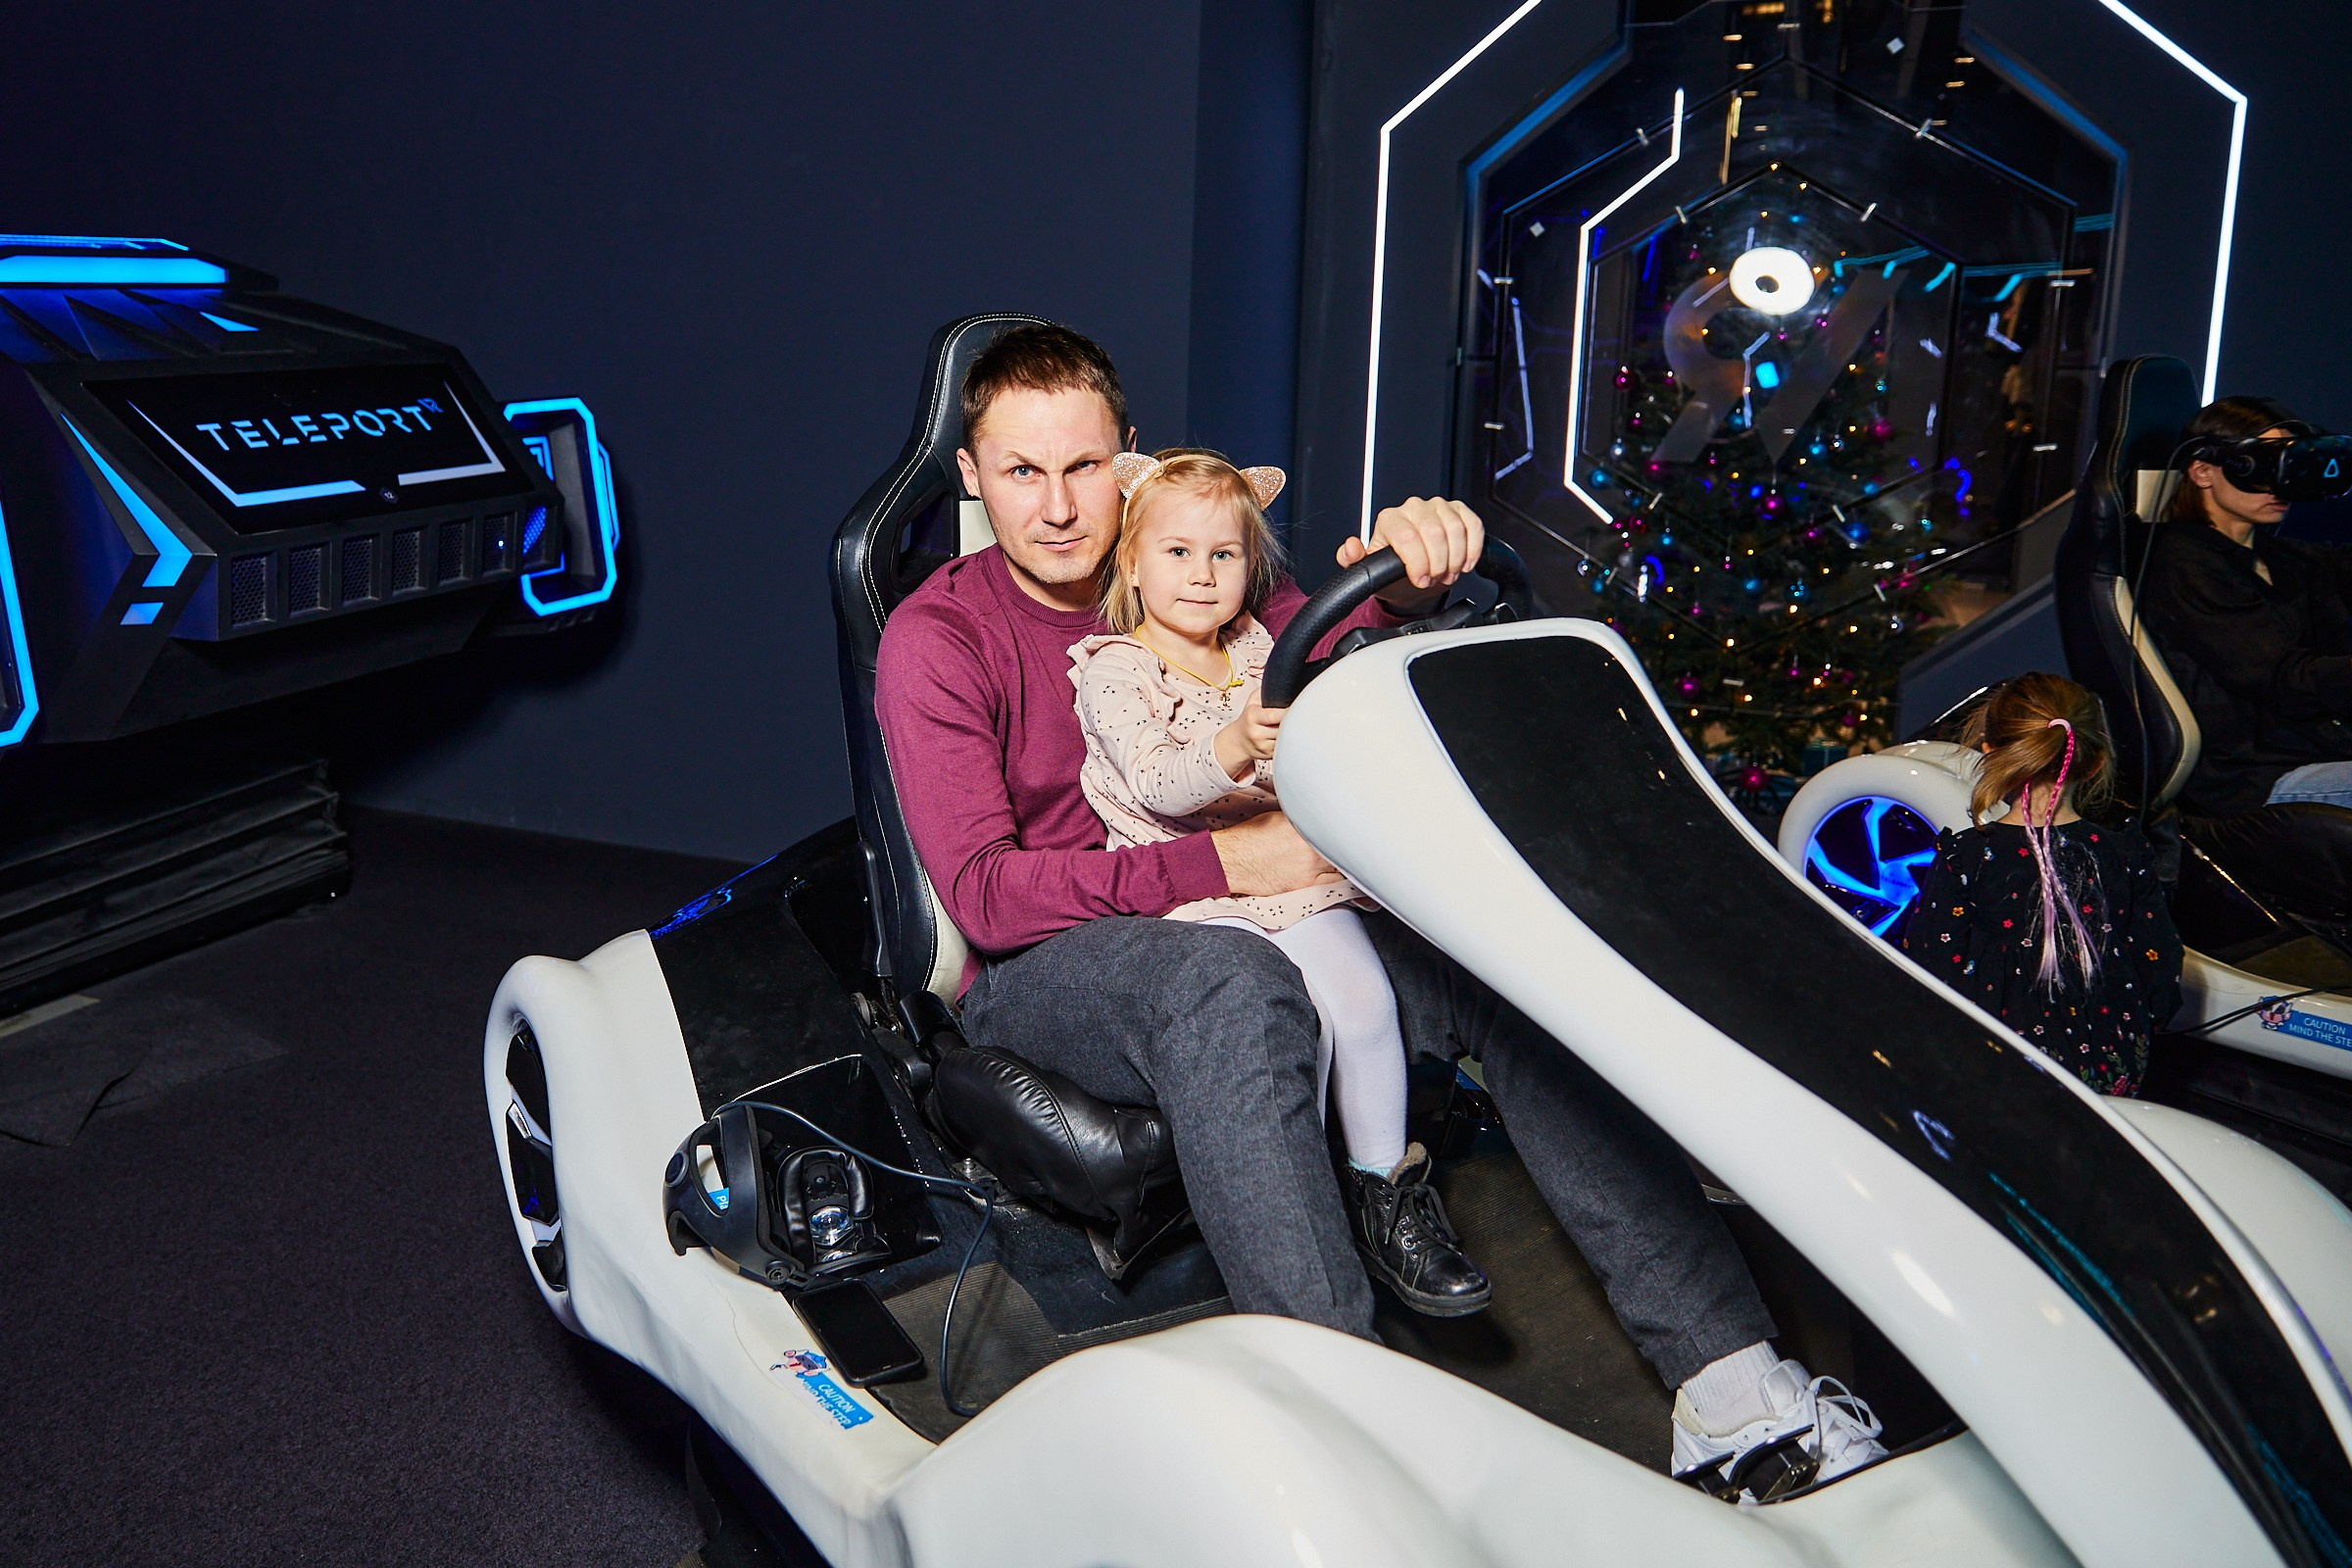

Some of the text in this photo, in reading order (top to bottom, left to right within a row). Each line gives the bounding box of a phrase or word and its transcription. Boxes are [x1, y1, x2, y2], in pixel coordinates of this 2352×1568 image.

[196, 406, 432, 451] TELEPORT
[2289, 1023, 2352, 1048] MIND THE STE
[2304, 1017, 2346, 1035] CAUTION
[818, 1384, 856, 1412] CAUTION
